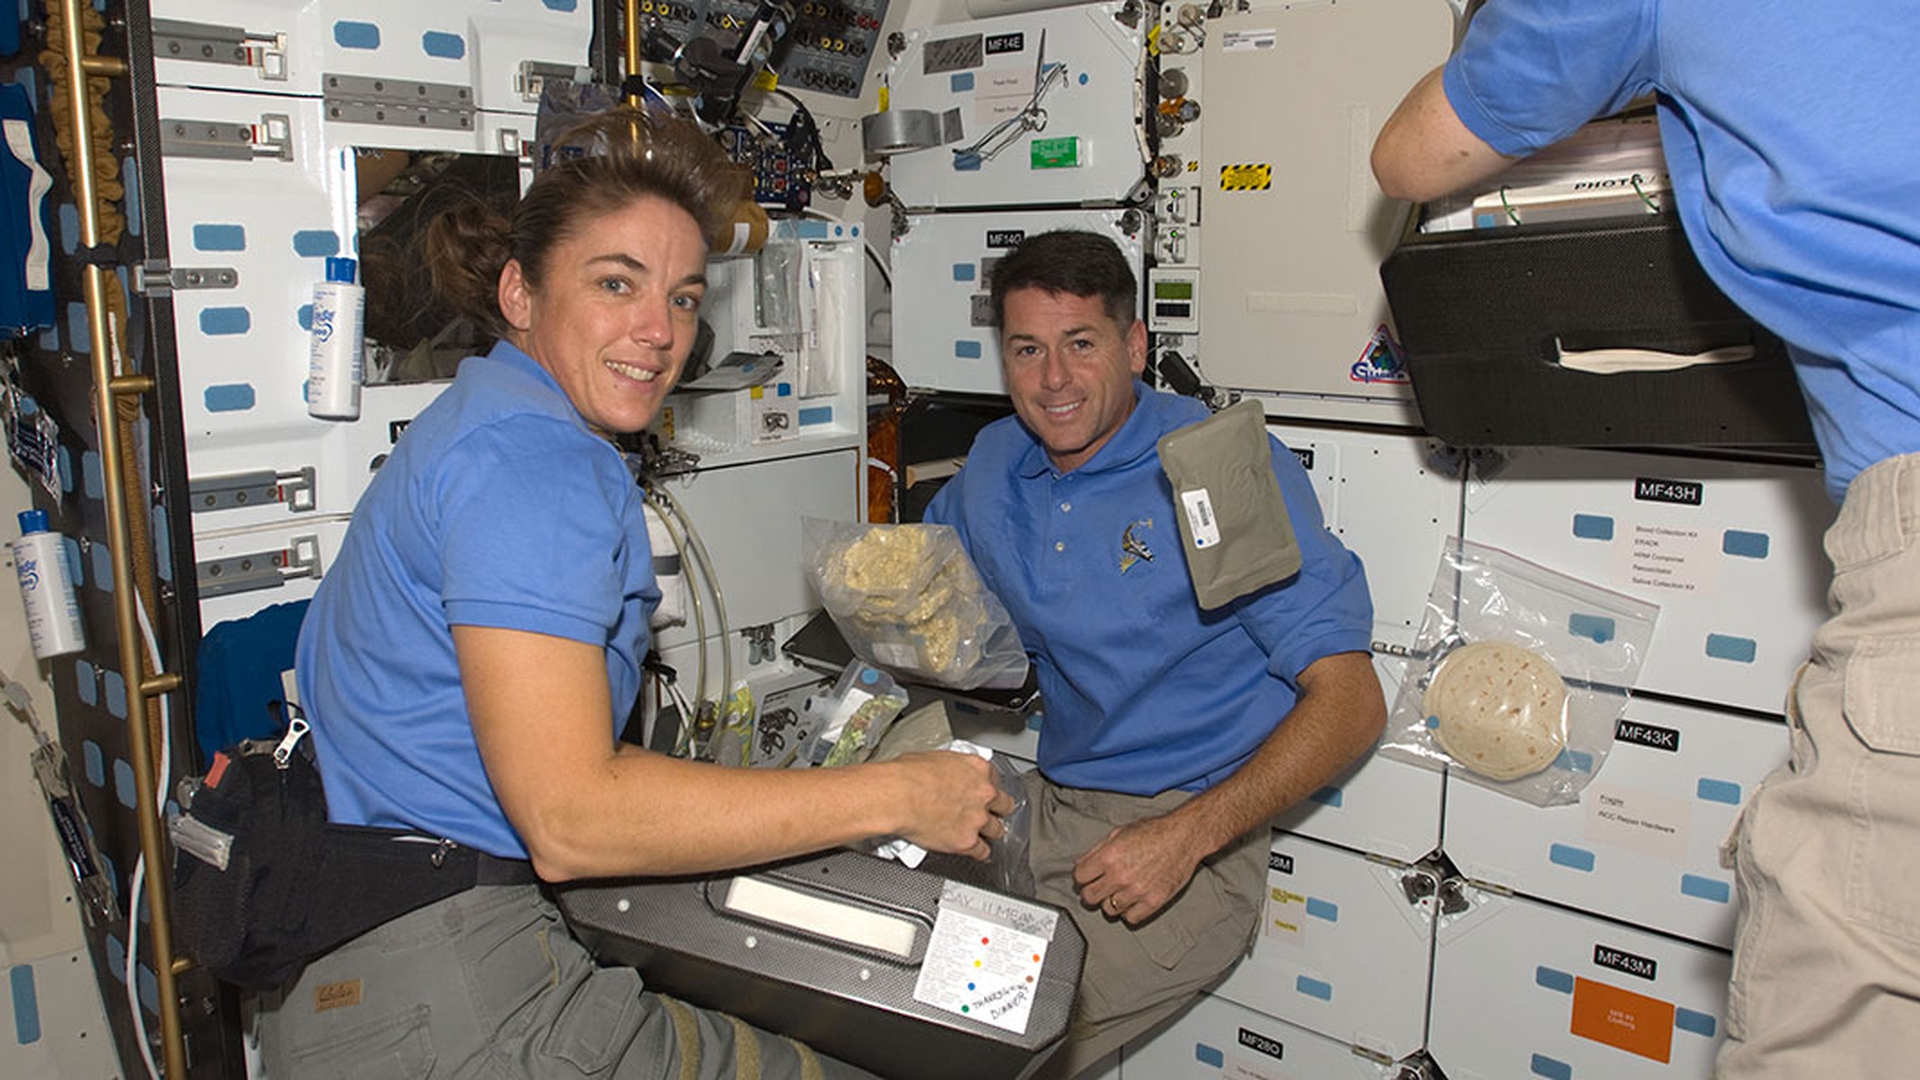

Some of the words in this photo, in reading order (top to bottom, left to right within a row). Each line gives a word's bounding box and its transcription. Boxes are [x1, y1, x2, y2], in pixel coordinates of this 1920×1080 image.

[988, 36, 1021, 51] MF14E
[1640, 483, 1697, 500] MF43H
[1620, 724, 1673, 747] MF43K
[1598, 949, 1652, 976] MF43M
